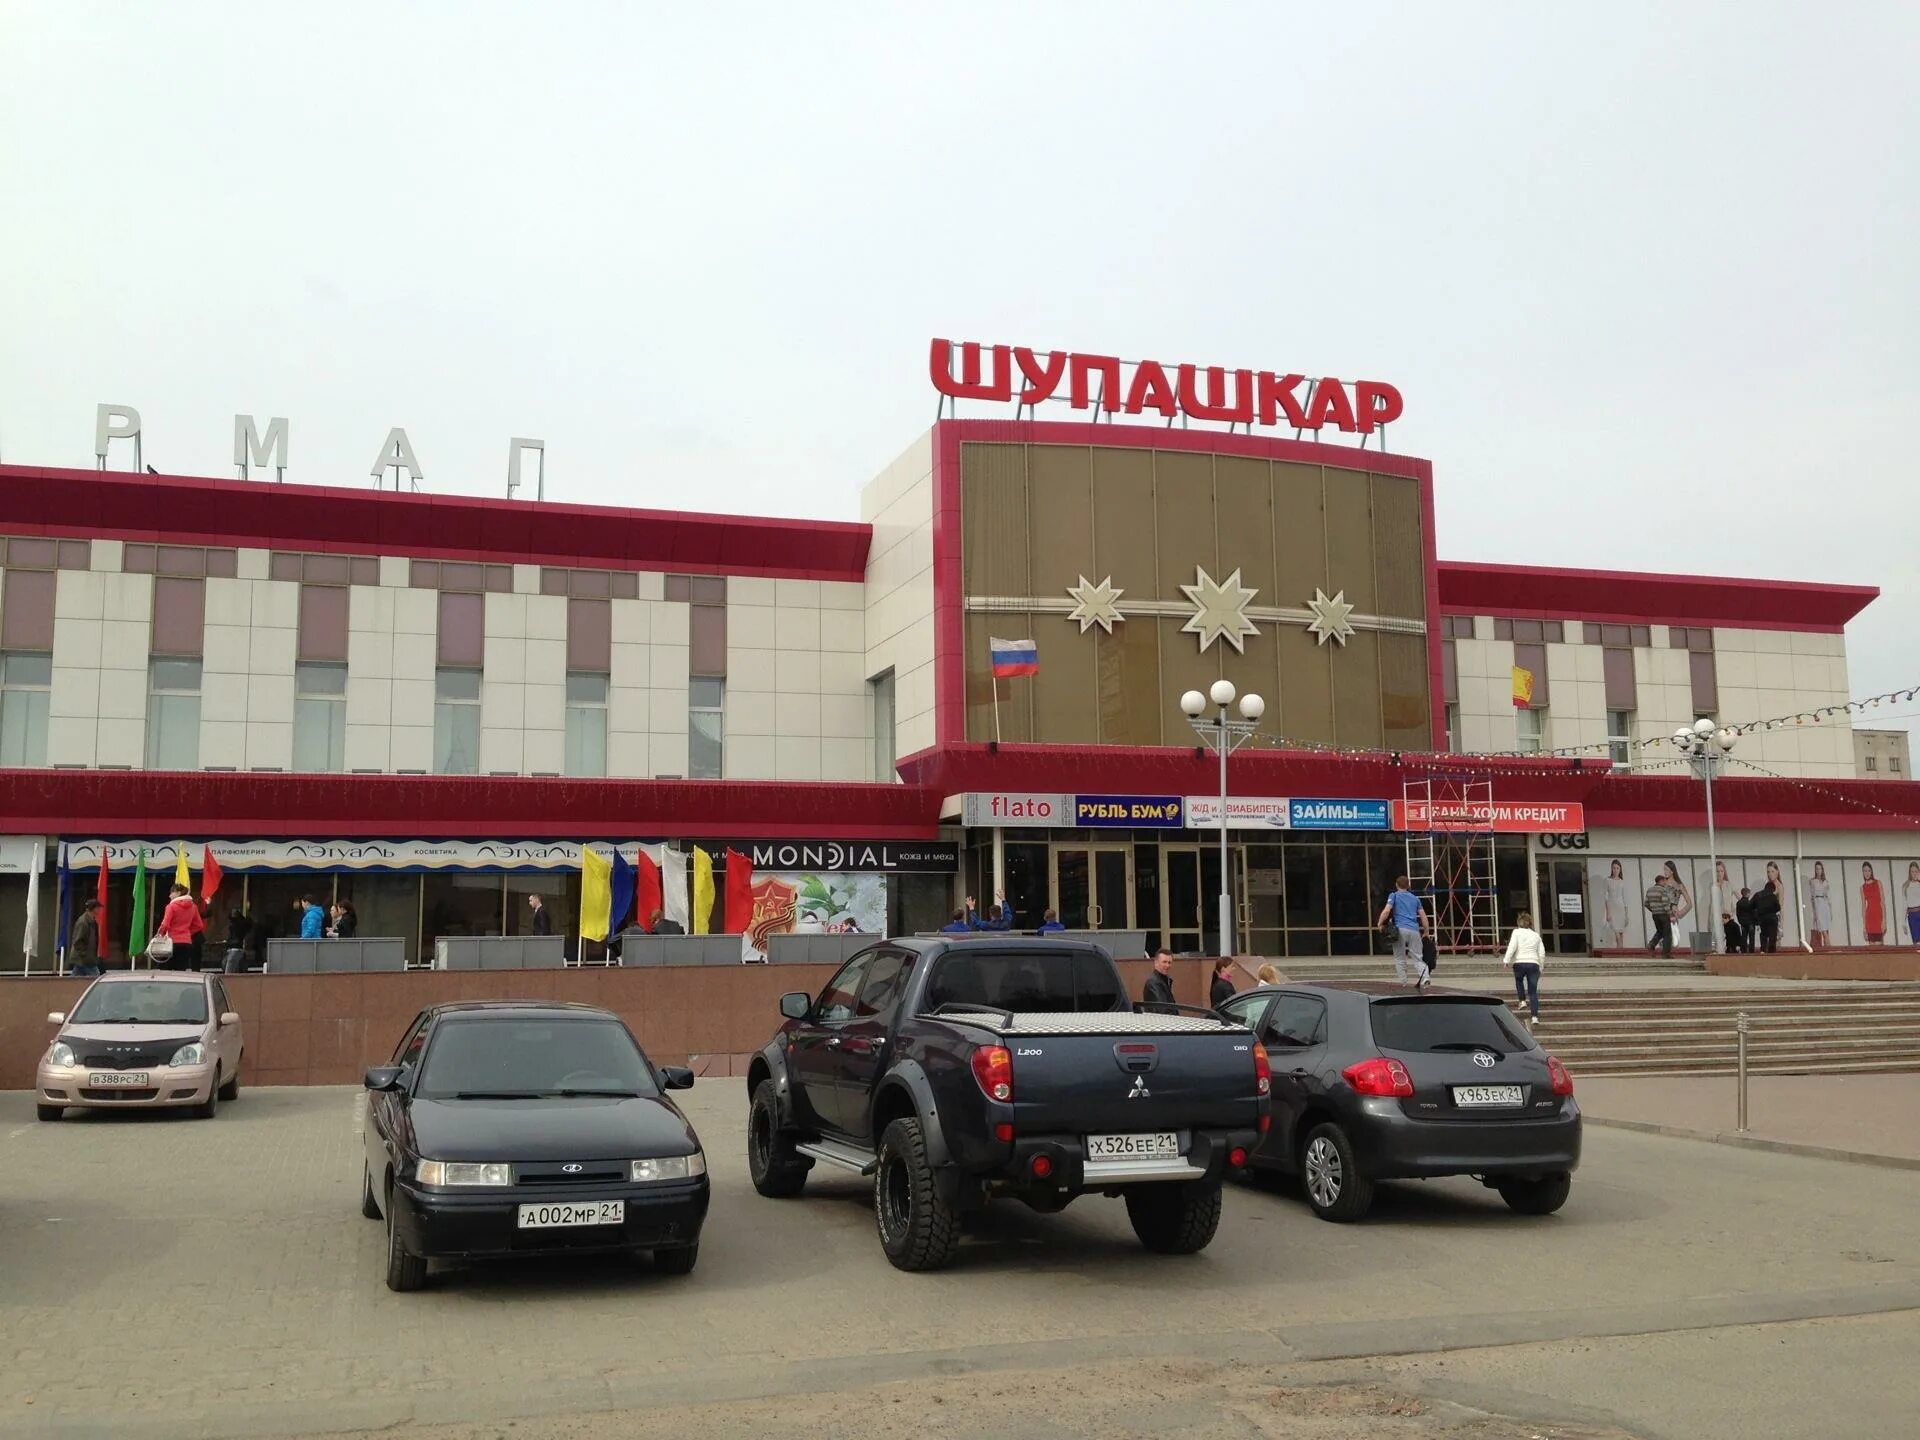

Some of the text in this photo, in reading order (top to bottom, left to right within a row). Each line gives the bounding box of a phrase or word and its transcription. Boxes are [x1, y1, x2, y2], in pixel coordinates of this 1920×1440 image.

[930, 338, 1404, 433] ШУПАШКАР
[991, 797, 1052, 818] flato
[1079, 803, 1162, 819] РУБЛЬ БУМ
[1221, 804, 1286, 814] ВИАБИЛЕТЫ
[1293, 801, 1358, 819] ЗАЙМЫ
[1515, 807, 1567, 823] КРЕДИТ
[1540, 832, 1590, 850] OGGI
[753, 842, 897, 870] MONDIAL
[1017, 1048, 1043, 1056] L200
[1094, 1134, 1173, 1154] Х526ЕЕ 21
[526, 1203, 619, 1225] А002МР 21
